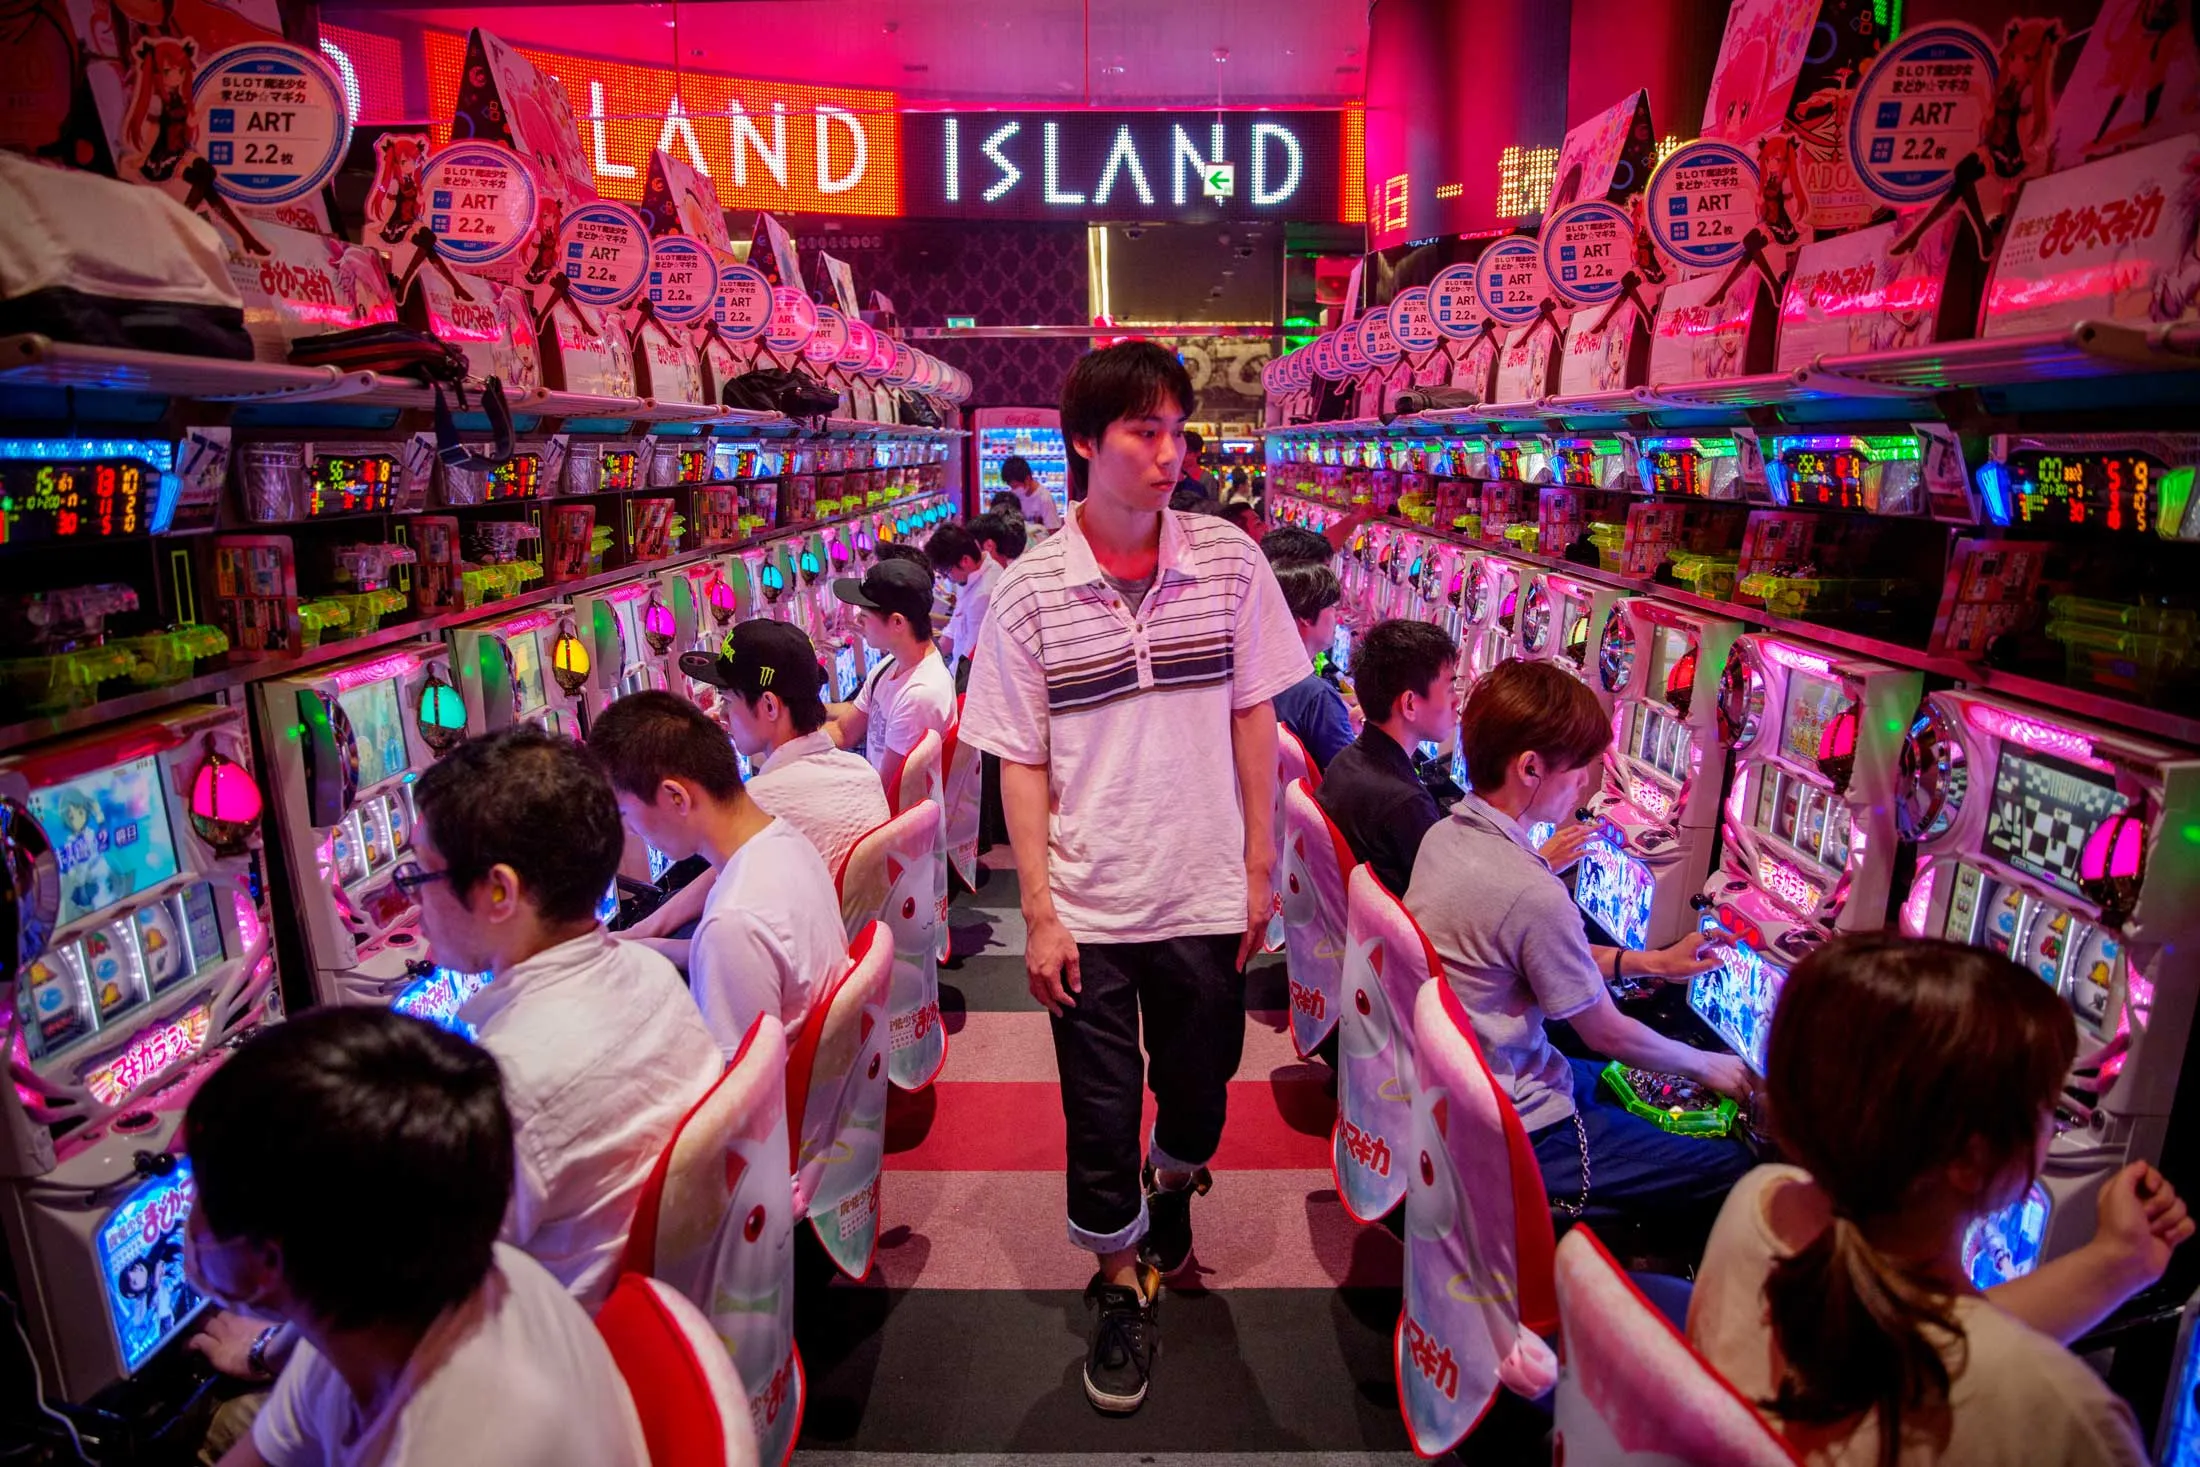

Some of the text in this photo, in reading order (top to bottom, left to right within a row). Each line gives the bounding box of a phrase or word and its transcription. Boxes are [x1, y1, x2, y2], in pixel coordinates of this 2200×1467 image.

[1909, 102, 1957, 125] ART
[247, 112, 296, 132] ART
[945, 117, 1303, 205] ISLAND
[461, 194, 498, 210] ART
[1697, 194, 1732, 212] ART
[590, 247, 620, 261] ART
[1583, 243, 1612, 258] ART
[668, 273, 692, 284] ART
[1509, 273, 1533, 285] ART
[730, 297, 751, 307] ART
[778, 315, 796, 324] ART
